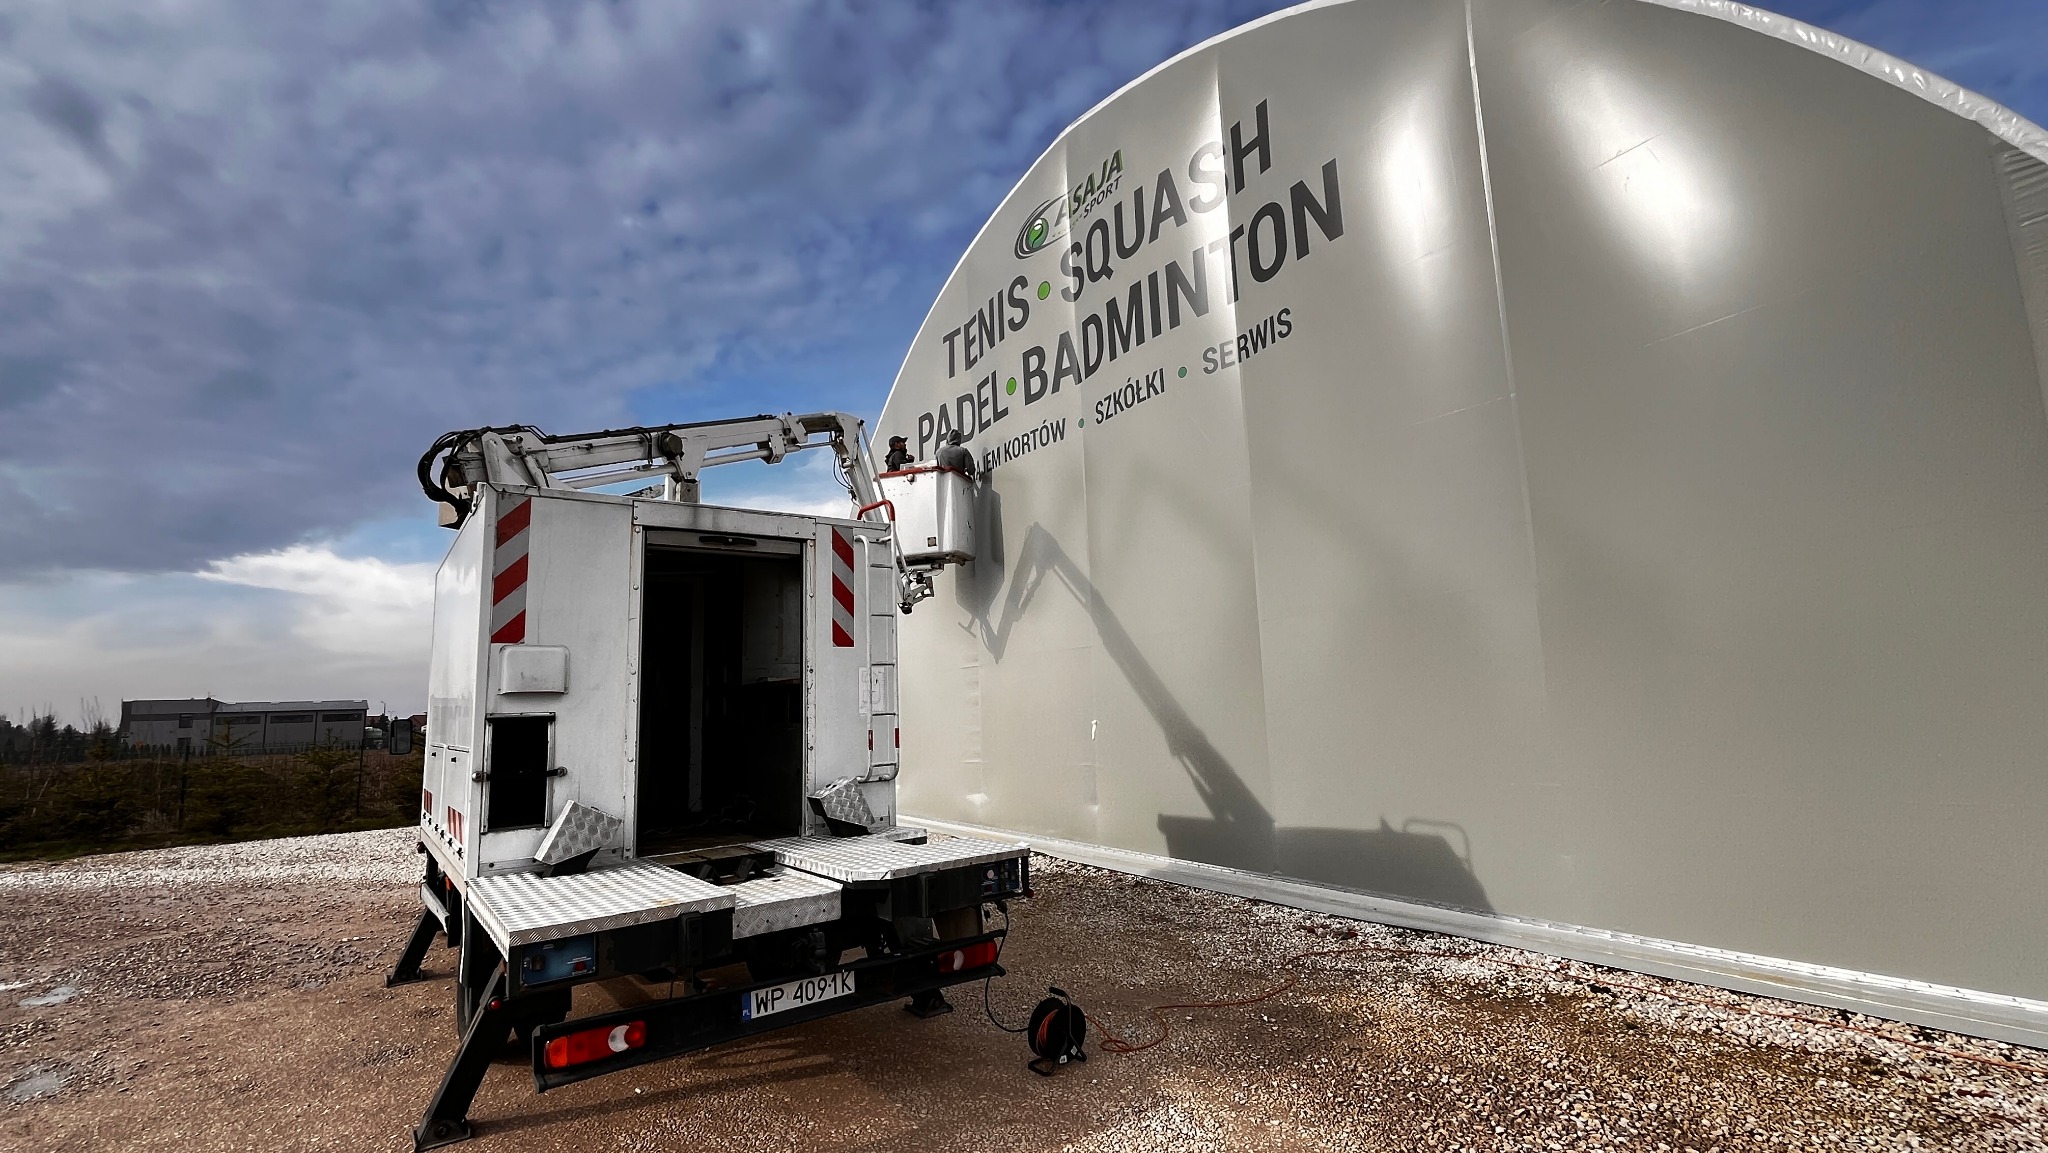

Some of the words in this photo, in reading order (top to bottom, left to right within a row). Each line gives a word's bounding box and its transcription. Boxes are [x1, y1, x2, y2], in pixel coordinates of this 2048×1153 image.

[942, 275, 1030, 379] TENIS
[1060, 98, 1272, 303] SQUASH
[1054, 149, 1123, 227] ASAJA
[1083, 175, 1122, 219] SPORT
[918, 370, 1009, 461] PADEL
[1022, 157, 1344, 406] BADMINTON
[1004, 417, 1066, 462] KORTÓW
[1095, 367, 1165, 425] SZKÓŁKI
[1202, 307, 1293, 375] SERWIS
[755, 987, 785, 1015] WP
[792, 970, 852, 1004] 4091K
